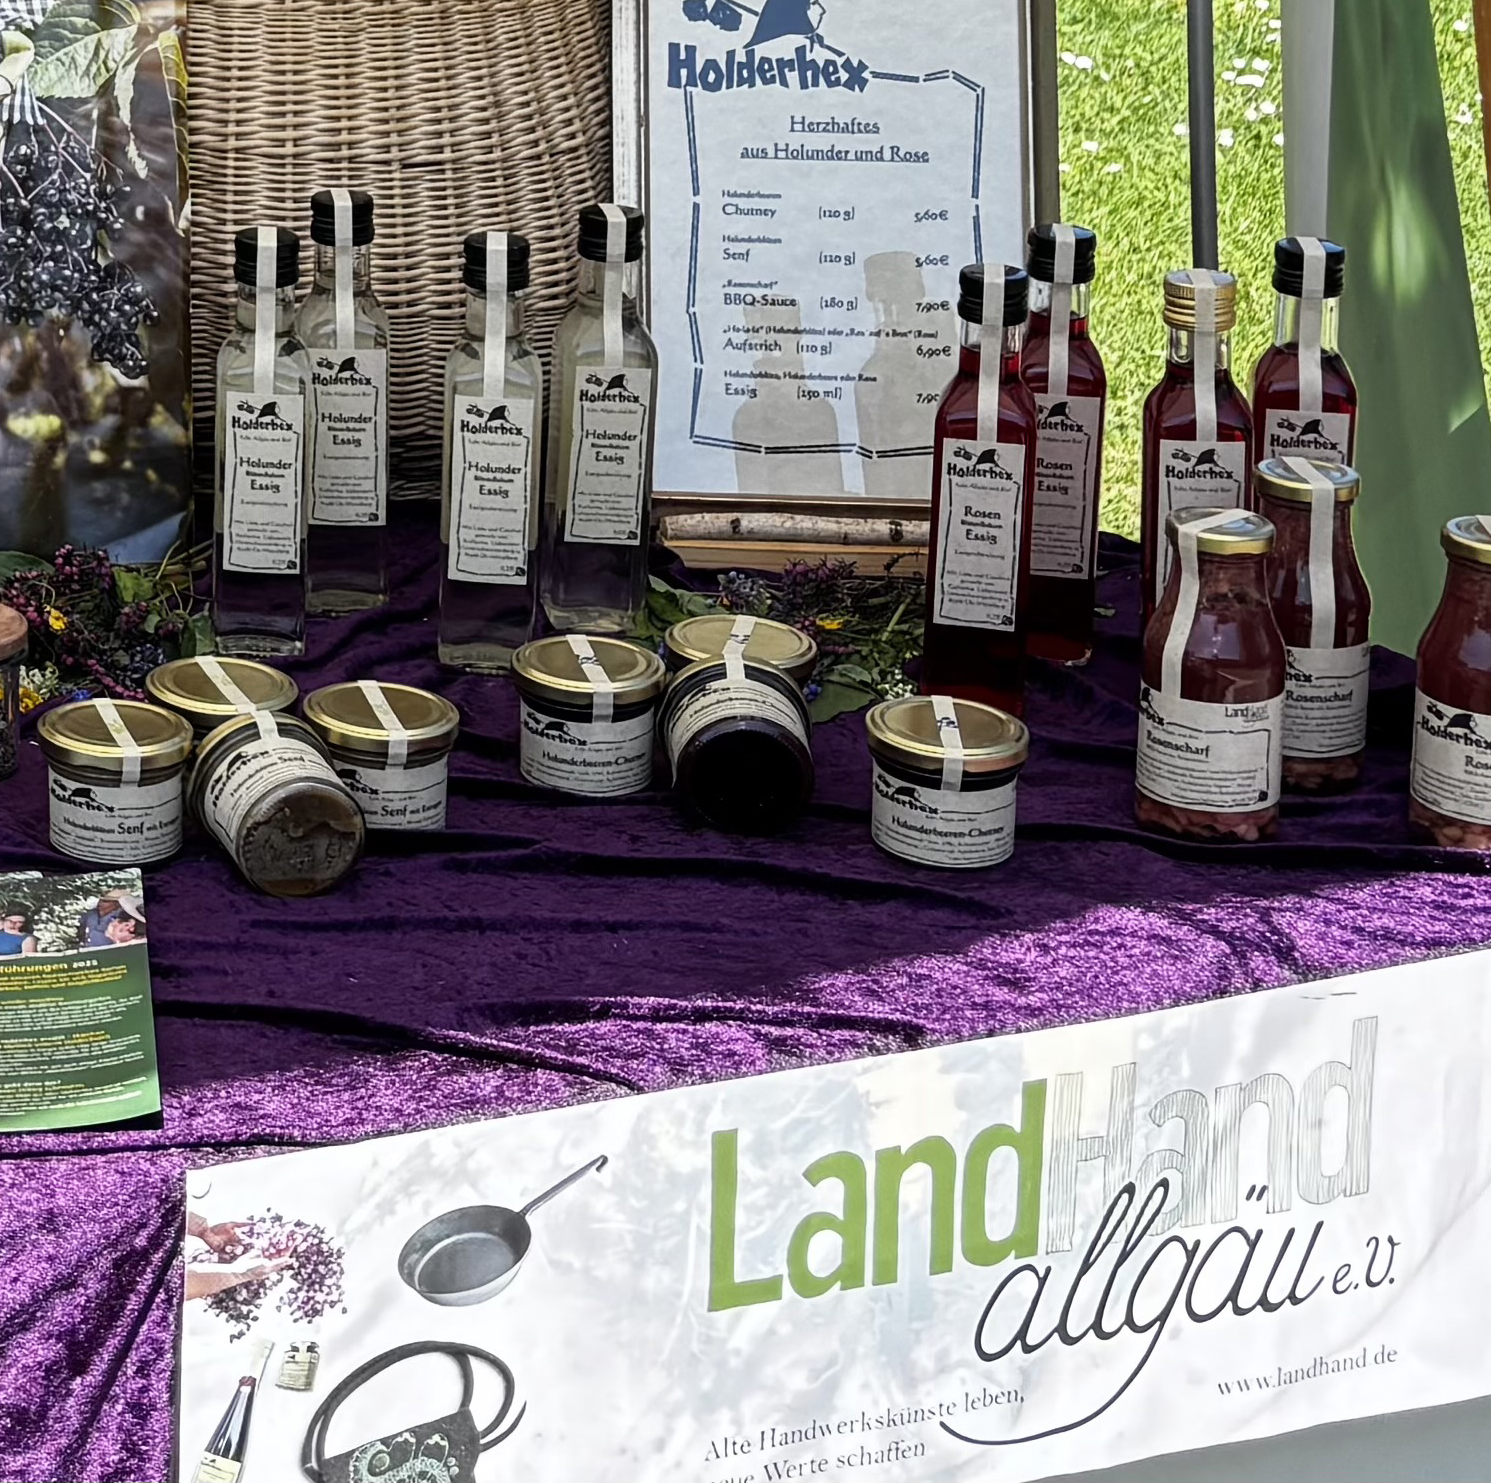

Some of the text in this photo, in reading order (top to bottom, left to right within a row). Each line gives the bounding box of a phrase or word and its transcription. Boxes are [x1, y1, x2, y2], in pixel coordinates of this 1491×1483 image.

[667, 42, 870, 93] Holderhex
[789, 115, 880, 133] Herzhaftes
[740, 143, 929, 162] aus Holunder und Rose
[722, 203, 776, 218] Chutney
[723, 248, 751, 263] Senf
[723, 293, 797, 307] BBQ-Sauce
[915, 300, 950, 313] 7,90€
[723, 338, 782, 352] Aufstrich
[916, 345, 951, 357] 6,90€
[312, 373, 372, 388] Holderhex
[579, 389, 640, 405] Holderhex
[725, 384, 757, 398] Essig
[916, 392, 940, 404] 7,90
[232, 415, 294, 433] Holderhex
[321, 413, 373, 426] Holunder
[460, 419, 523, 437] Holderhex
[585, 428, 638, 443] Holunder
[332, 434, 362, 449] Essig
[1270, 434, 1339, 452] Holderhex
[239, 457, 293, 472] Holunder
[594, 451, 625, 466] Essig
[1036, 458, 1073, 473] Rosen
[467, 461, 523, 476] Holunder
[946, 462, 1014, 482] Holderhex
[1164, 464, 1234, 482] Holderhex
[249, 479, 281, 494] Essig
[478, 483, 510, 499] Essig
[1037, 480, 1070, 496] Essig
[963, 505, 1002, 521] Rosen
[965, 528, 999, 545] Essig
[380, 804, 408, 818] Senf
[117, 821, 144, 835] Senf
[941, 1178, 1401, 1445] allgäu e.V.
[1217, 1344, 1398, 1397] www.landhand.de
[704, 1388, 1026, 1461] Alte Handwerkskünste leben,
[764, 1439, 926, 1480] Werte schaffen
